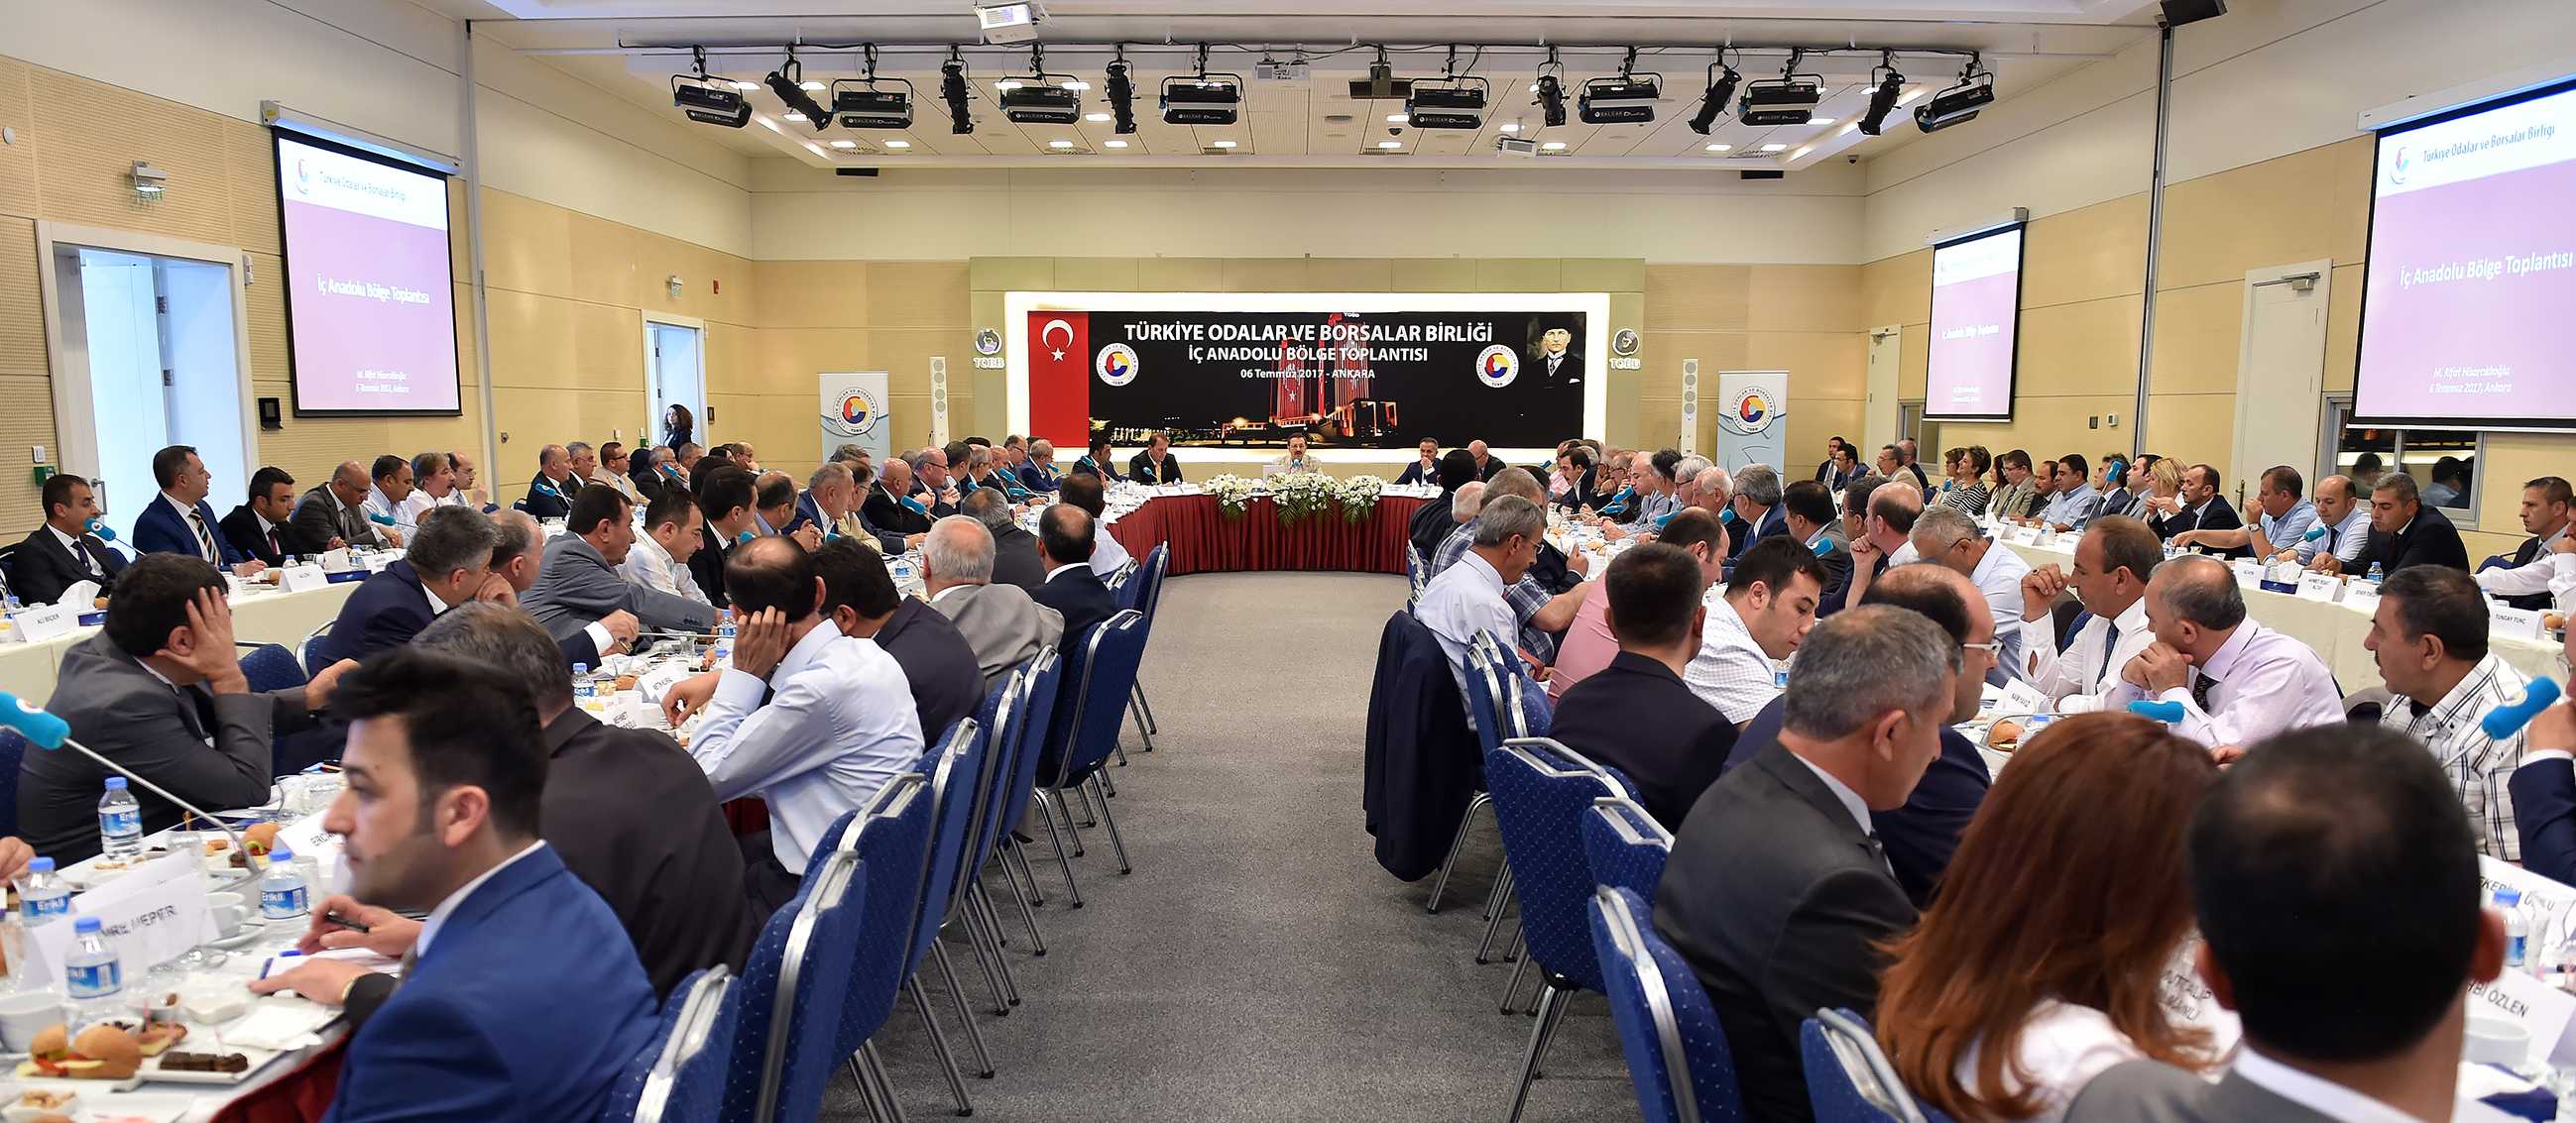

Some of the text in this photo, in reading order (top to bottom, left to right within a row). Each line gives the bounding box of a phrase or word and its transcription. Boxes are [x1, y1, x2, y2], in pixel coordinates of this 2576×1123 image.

[2400, 251, 2573, 290] İç Anadolu Bölge Toplantısı
[1123, 320, 1493, 342] TÜRKİYE ODALAR VE BORSALAR BİRLİĞİ
[1189, 344, 1428, 364] İÇ ANADOLU BÖLGE TOPLANTISI
[1240, 369, 1253, 379] 06
[1254, 369, 1297, 379] Temmuz
[1300, 369, 1324, 379] 2017
[1332, 369, 1375, 379] ANKARA
